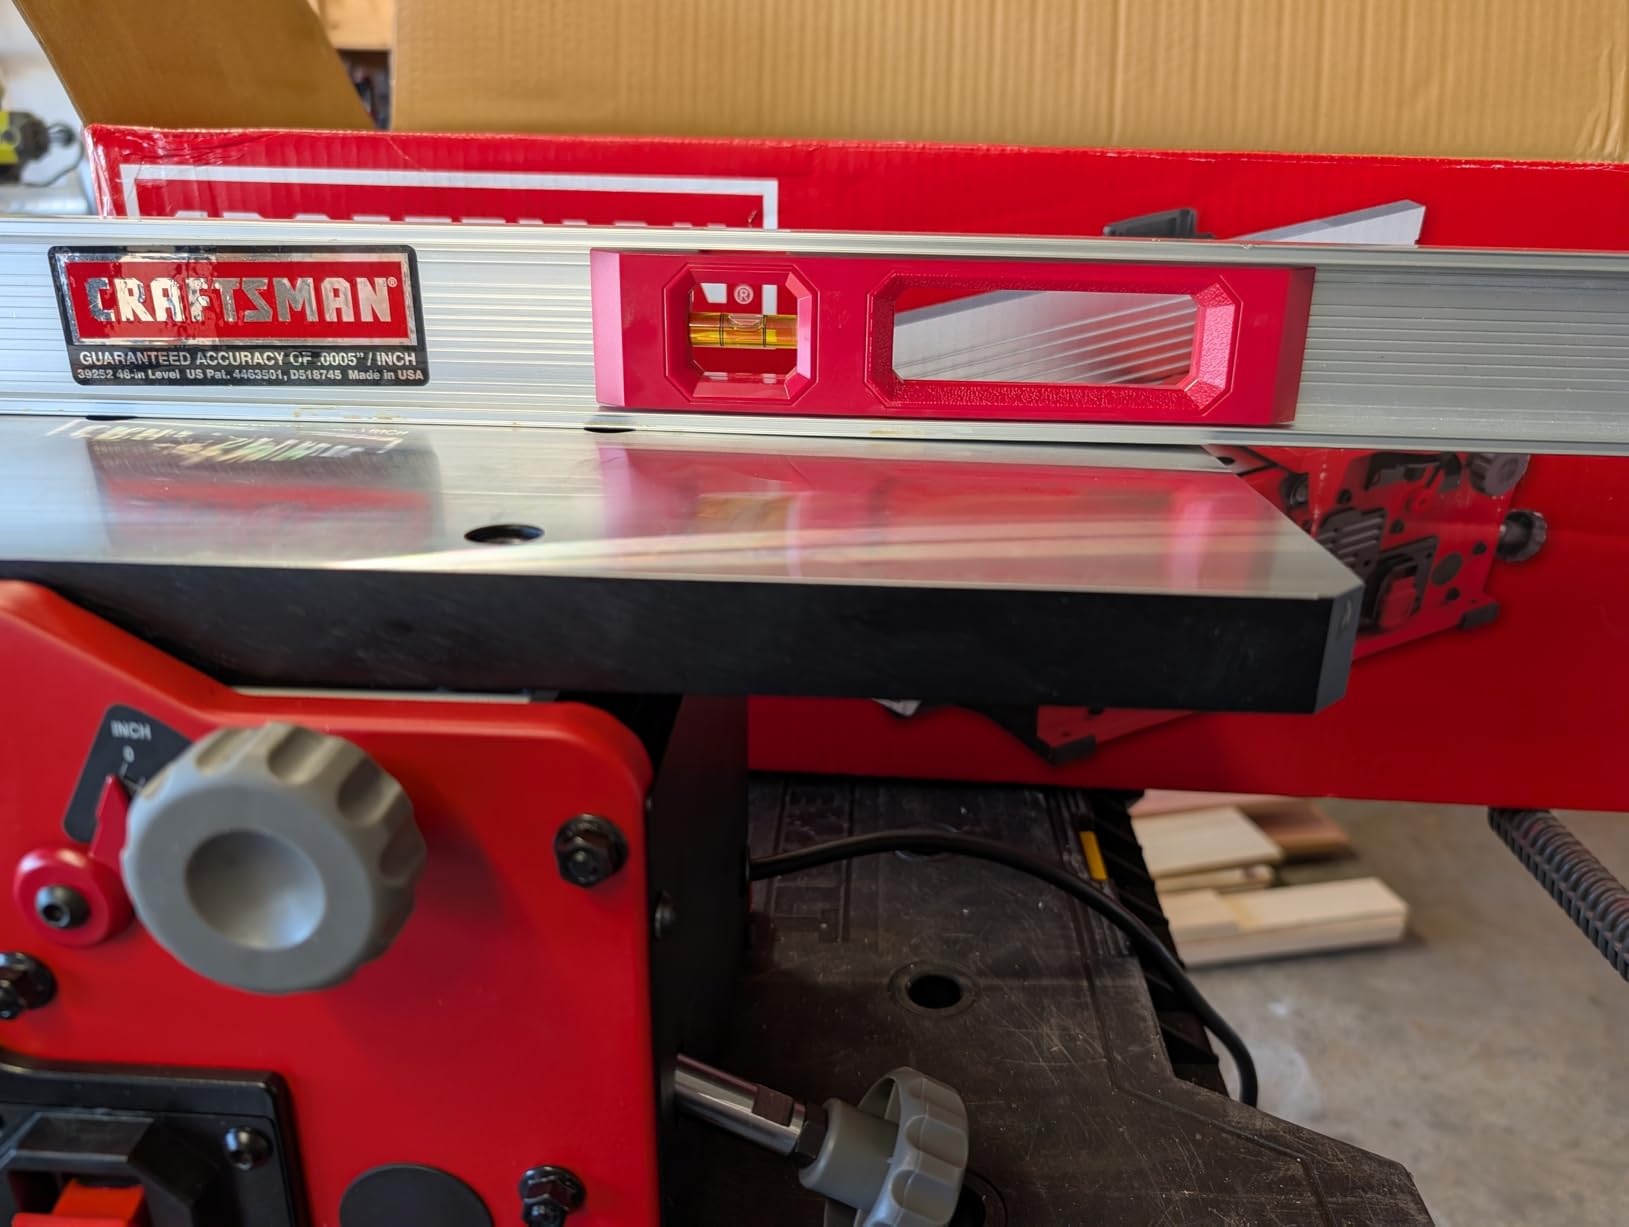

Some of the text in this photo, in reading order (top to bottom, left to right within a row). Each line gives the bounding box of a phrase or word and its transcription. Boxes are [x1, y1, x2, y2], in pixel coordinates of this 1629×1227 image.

[79, 351, 191, 366] GUARANTEED
[196, 352, 284, 366] ACCURACY
[290, 352, 312, 366] OF
[376, 352, 417, 366] INCH
[77, 369, 425, 381] 39252 48-in Level US Pat. 4463501, D518745 Made in USA
[110, 720, 152, 741] INCH
[122, 745, 135, 763] 0
